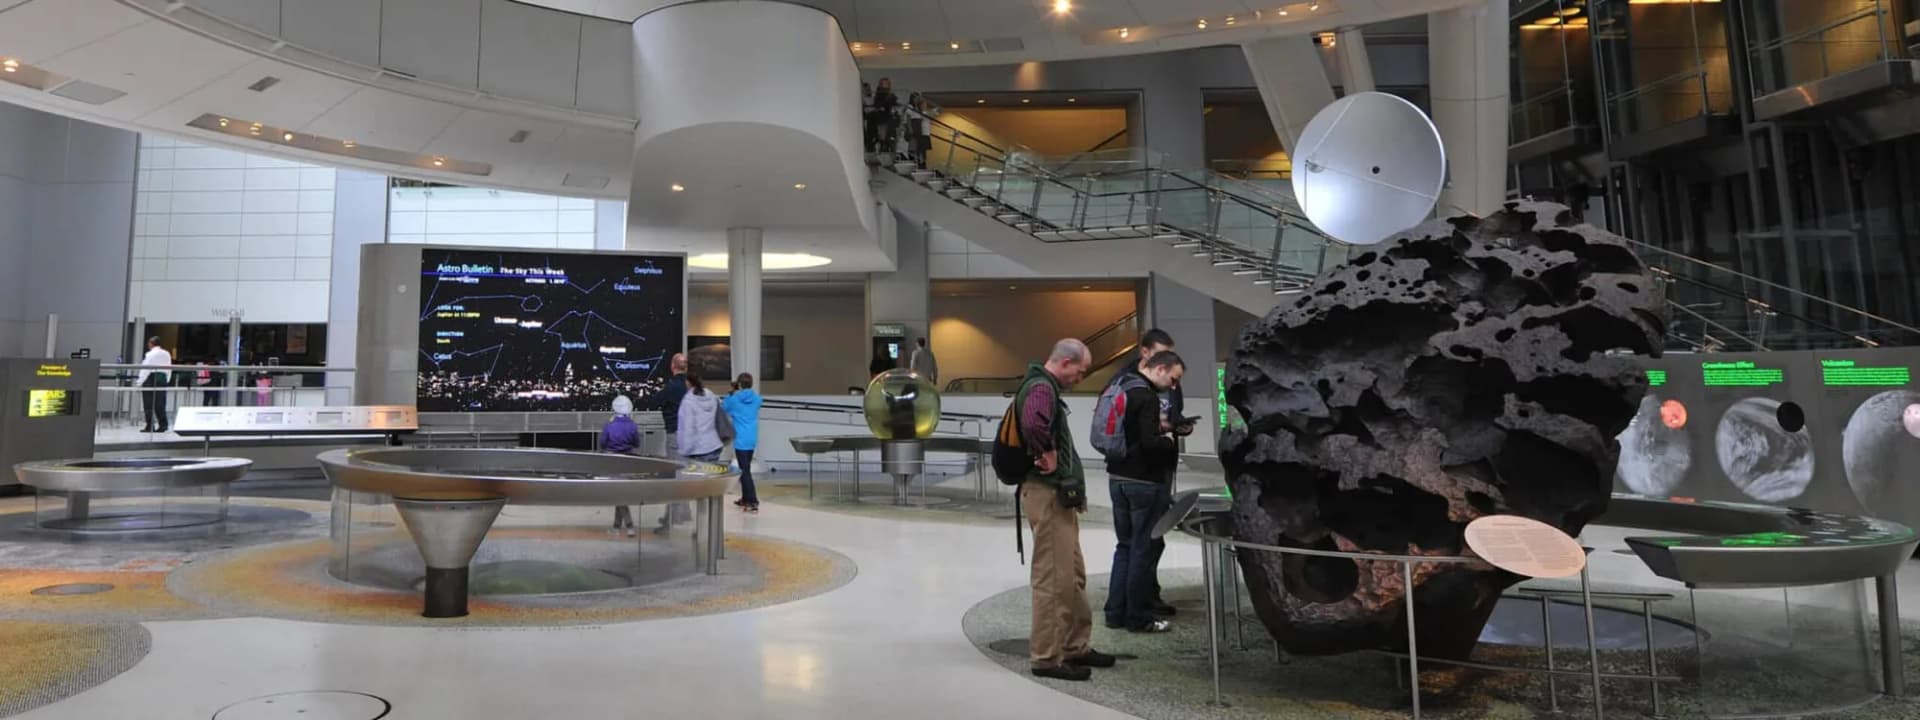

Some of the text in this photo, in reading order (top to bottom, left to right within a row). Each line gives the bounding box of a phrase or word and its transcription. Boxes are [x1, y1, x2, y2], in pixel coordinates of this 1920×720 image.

[437, 264, 565, 276] Astro Bulletin The Sky This Week
[561, 342, 587, 350] Aquarius
[433, 352, 453, 360] Cetus
[1217, 367, 1227, 429] PLANE
